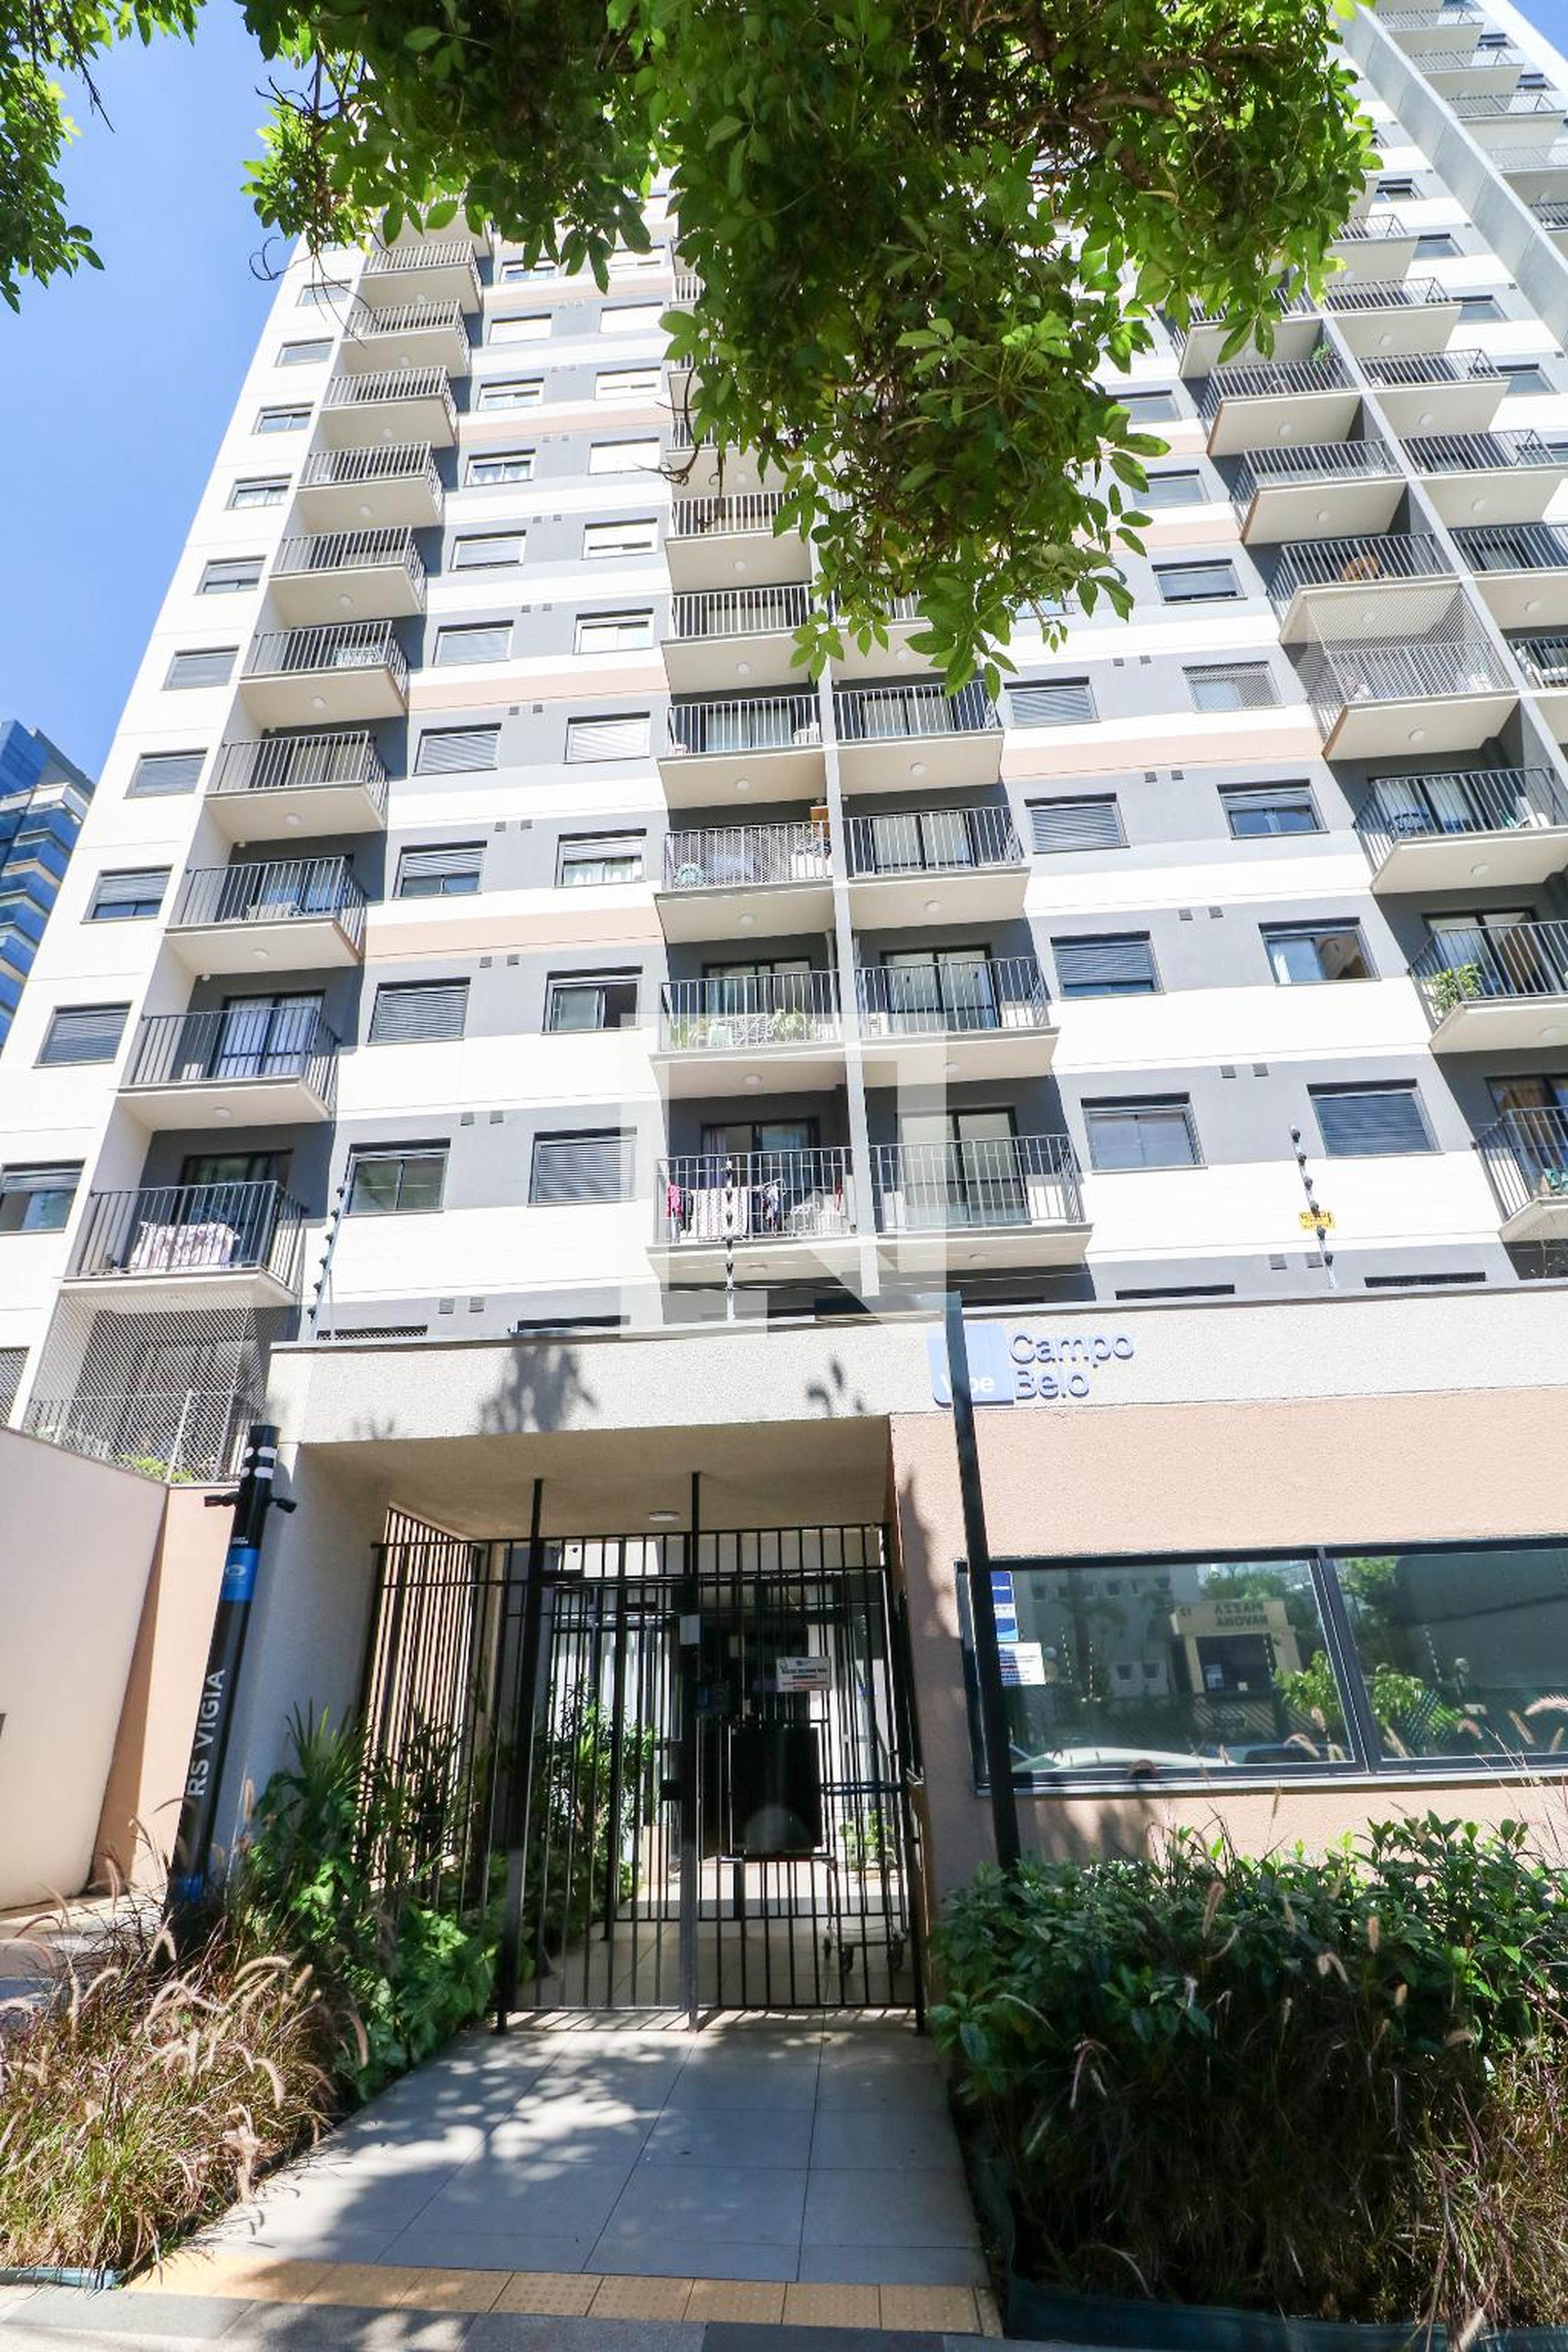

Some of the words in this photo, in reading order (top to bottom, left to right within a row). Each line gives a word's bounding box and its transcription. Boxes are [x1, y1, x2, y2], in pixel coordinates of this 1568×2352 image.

[1010, 1334, 1134, 1368] Campo
[1015, 1368, 1089, 1399] Belo
[195, 1669, 225, 1749] VIGIA
[186, 1759, 209, 1795] RS
